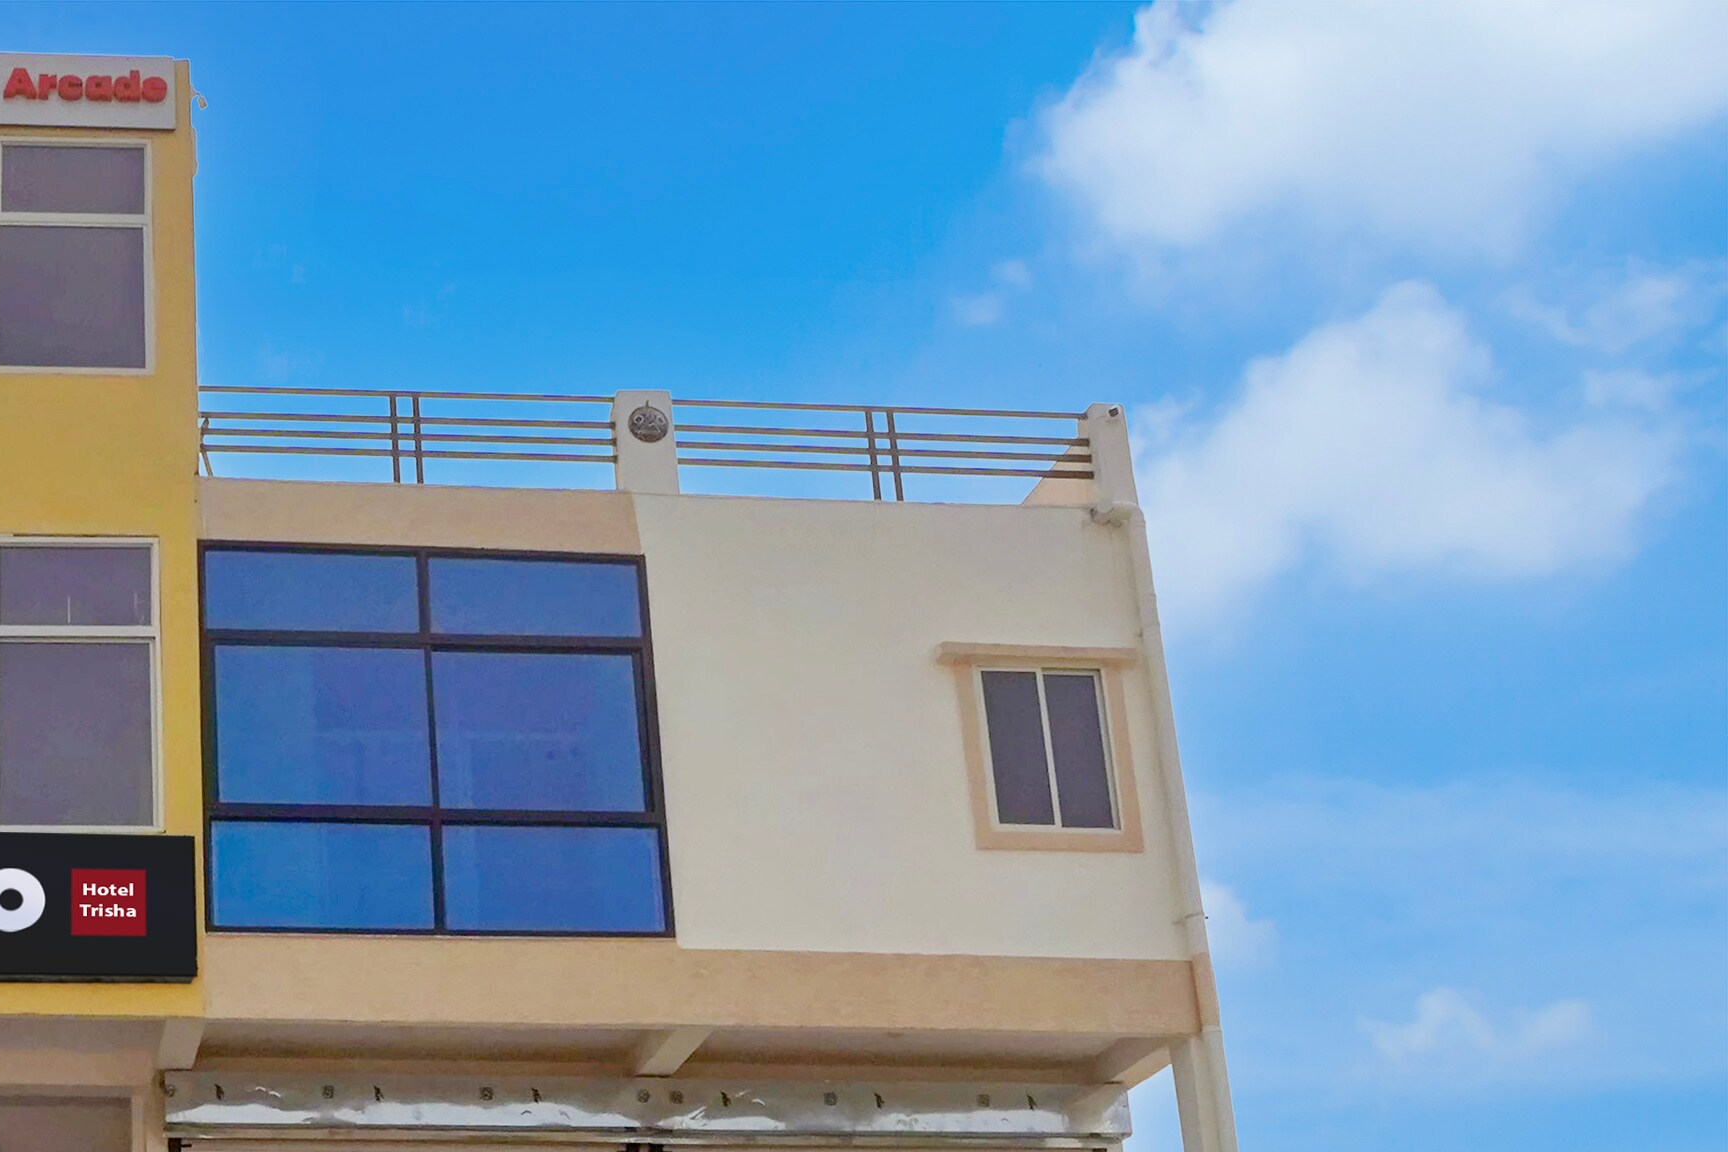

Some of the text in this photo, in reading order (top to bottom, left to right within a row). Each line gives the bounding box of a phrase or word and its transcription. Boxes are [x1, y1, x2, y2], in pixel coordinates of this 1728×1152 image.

[3, 67, 169, 103] Arcade
[82, 882, 135, 897] Hotel
[79, 903, 137, 918] Trisha
